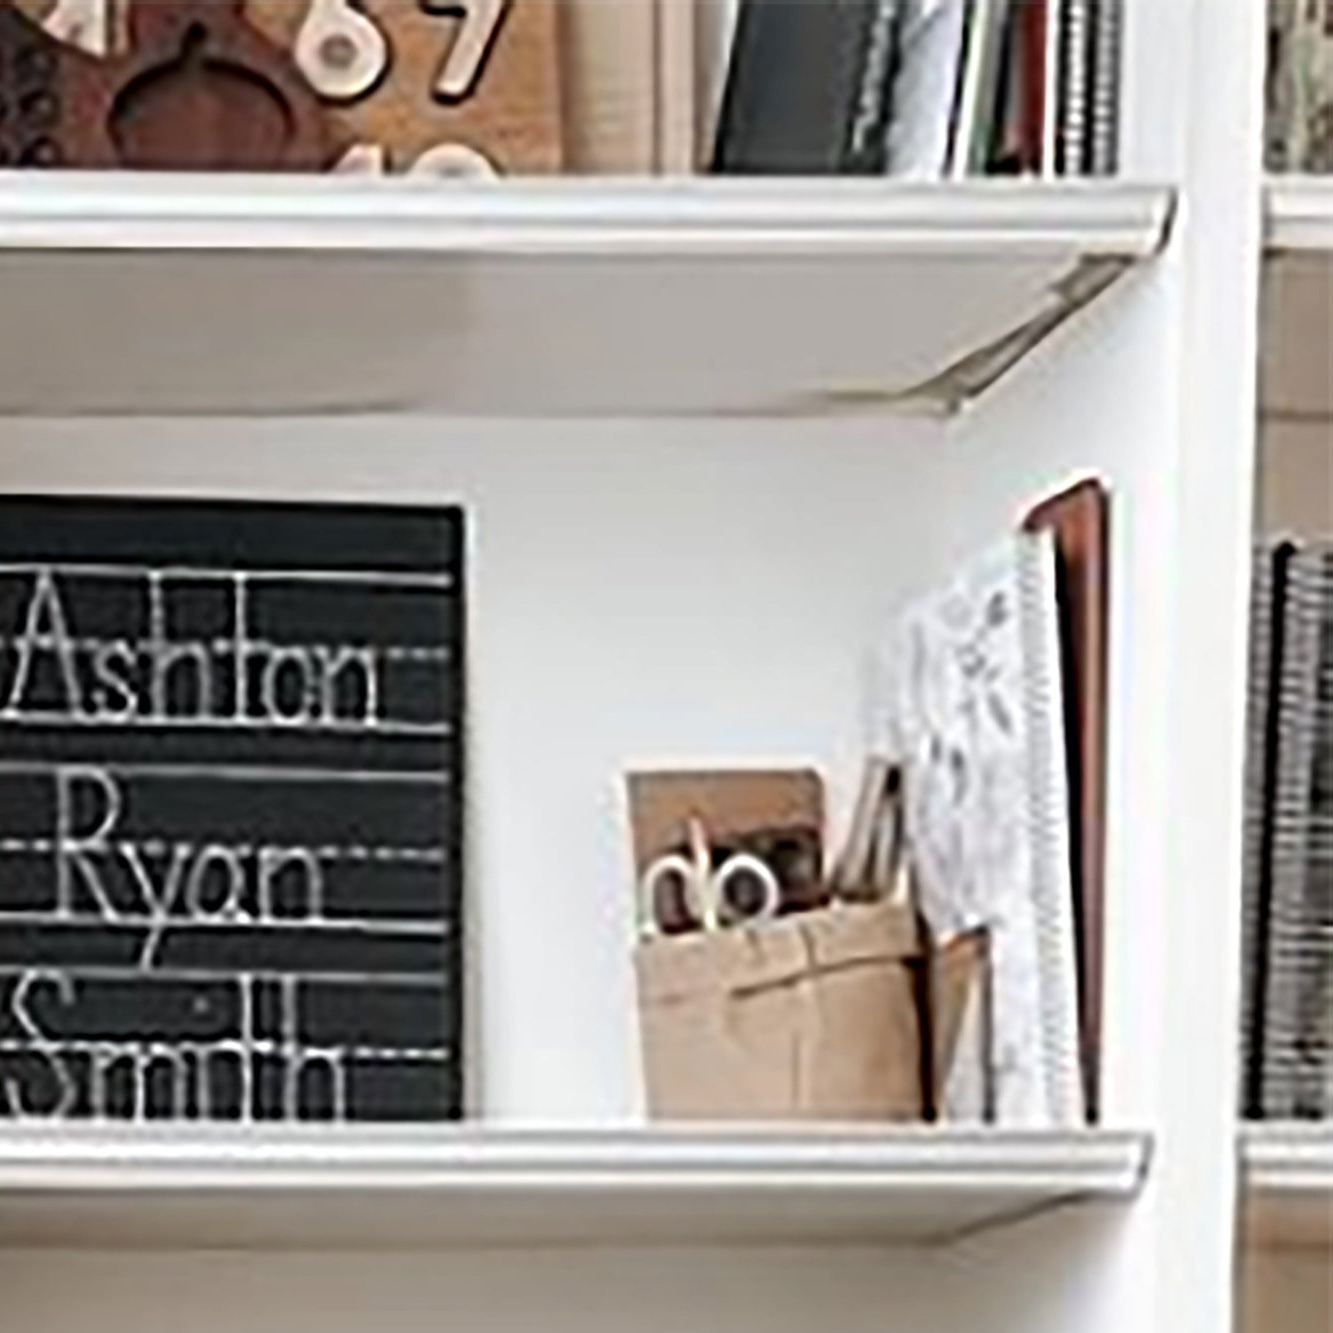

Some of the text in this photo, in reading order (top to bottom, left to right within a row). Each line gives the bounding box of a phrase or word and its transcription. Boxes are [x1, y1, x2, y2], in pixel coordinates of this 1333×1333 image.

[3, 566, 379, 726] Ashton
[55, 766, 323, 969] Ryan
[4, 970, 346, 1121] Smith
